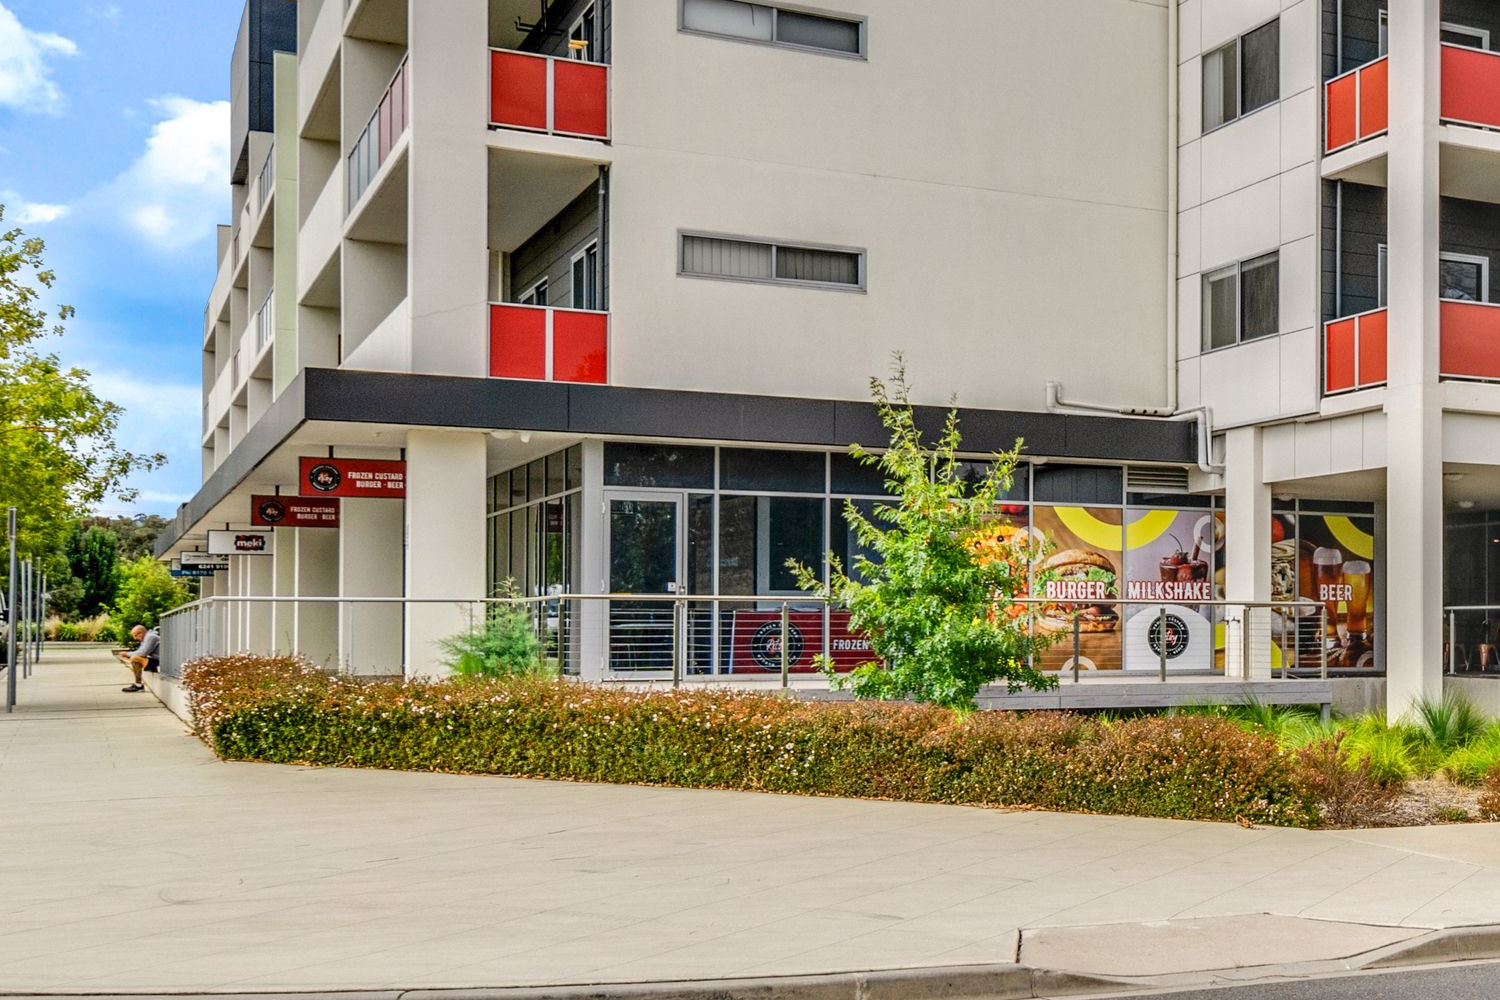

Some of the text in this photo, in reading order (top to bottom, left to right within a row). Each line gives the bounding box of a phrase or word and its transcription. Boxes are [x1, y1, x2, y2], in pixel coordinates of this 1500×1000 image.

[347, 471, 404, 481] FROZEN CUSTARD
[355, 480, 404, 489] BURGER BEER
[236, 538, 263, 547] meki
[1046, 581, 1106, 600] BURGER
[1127, 581, 1211, 600] MILKSHAKE
[1320, 584, 1353, 601] BEER
[832, 639, 869, 650] FROZEN
